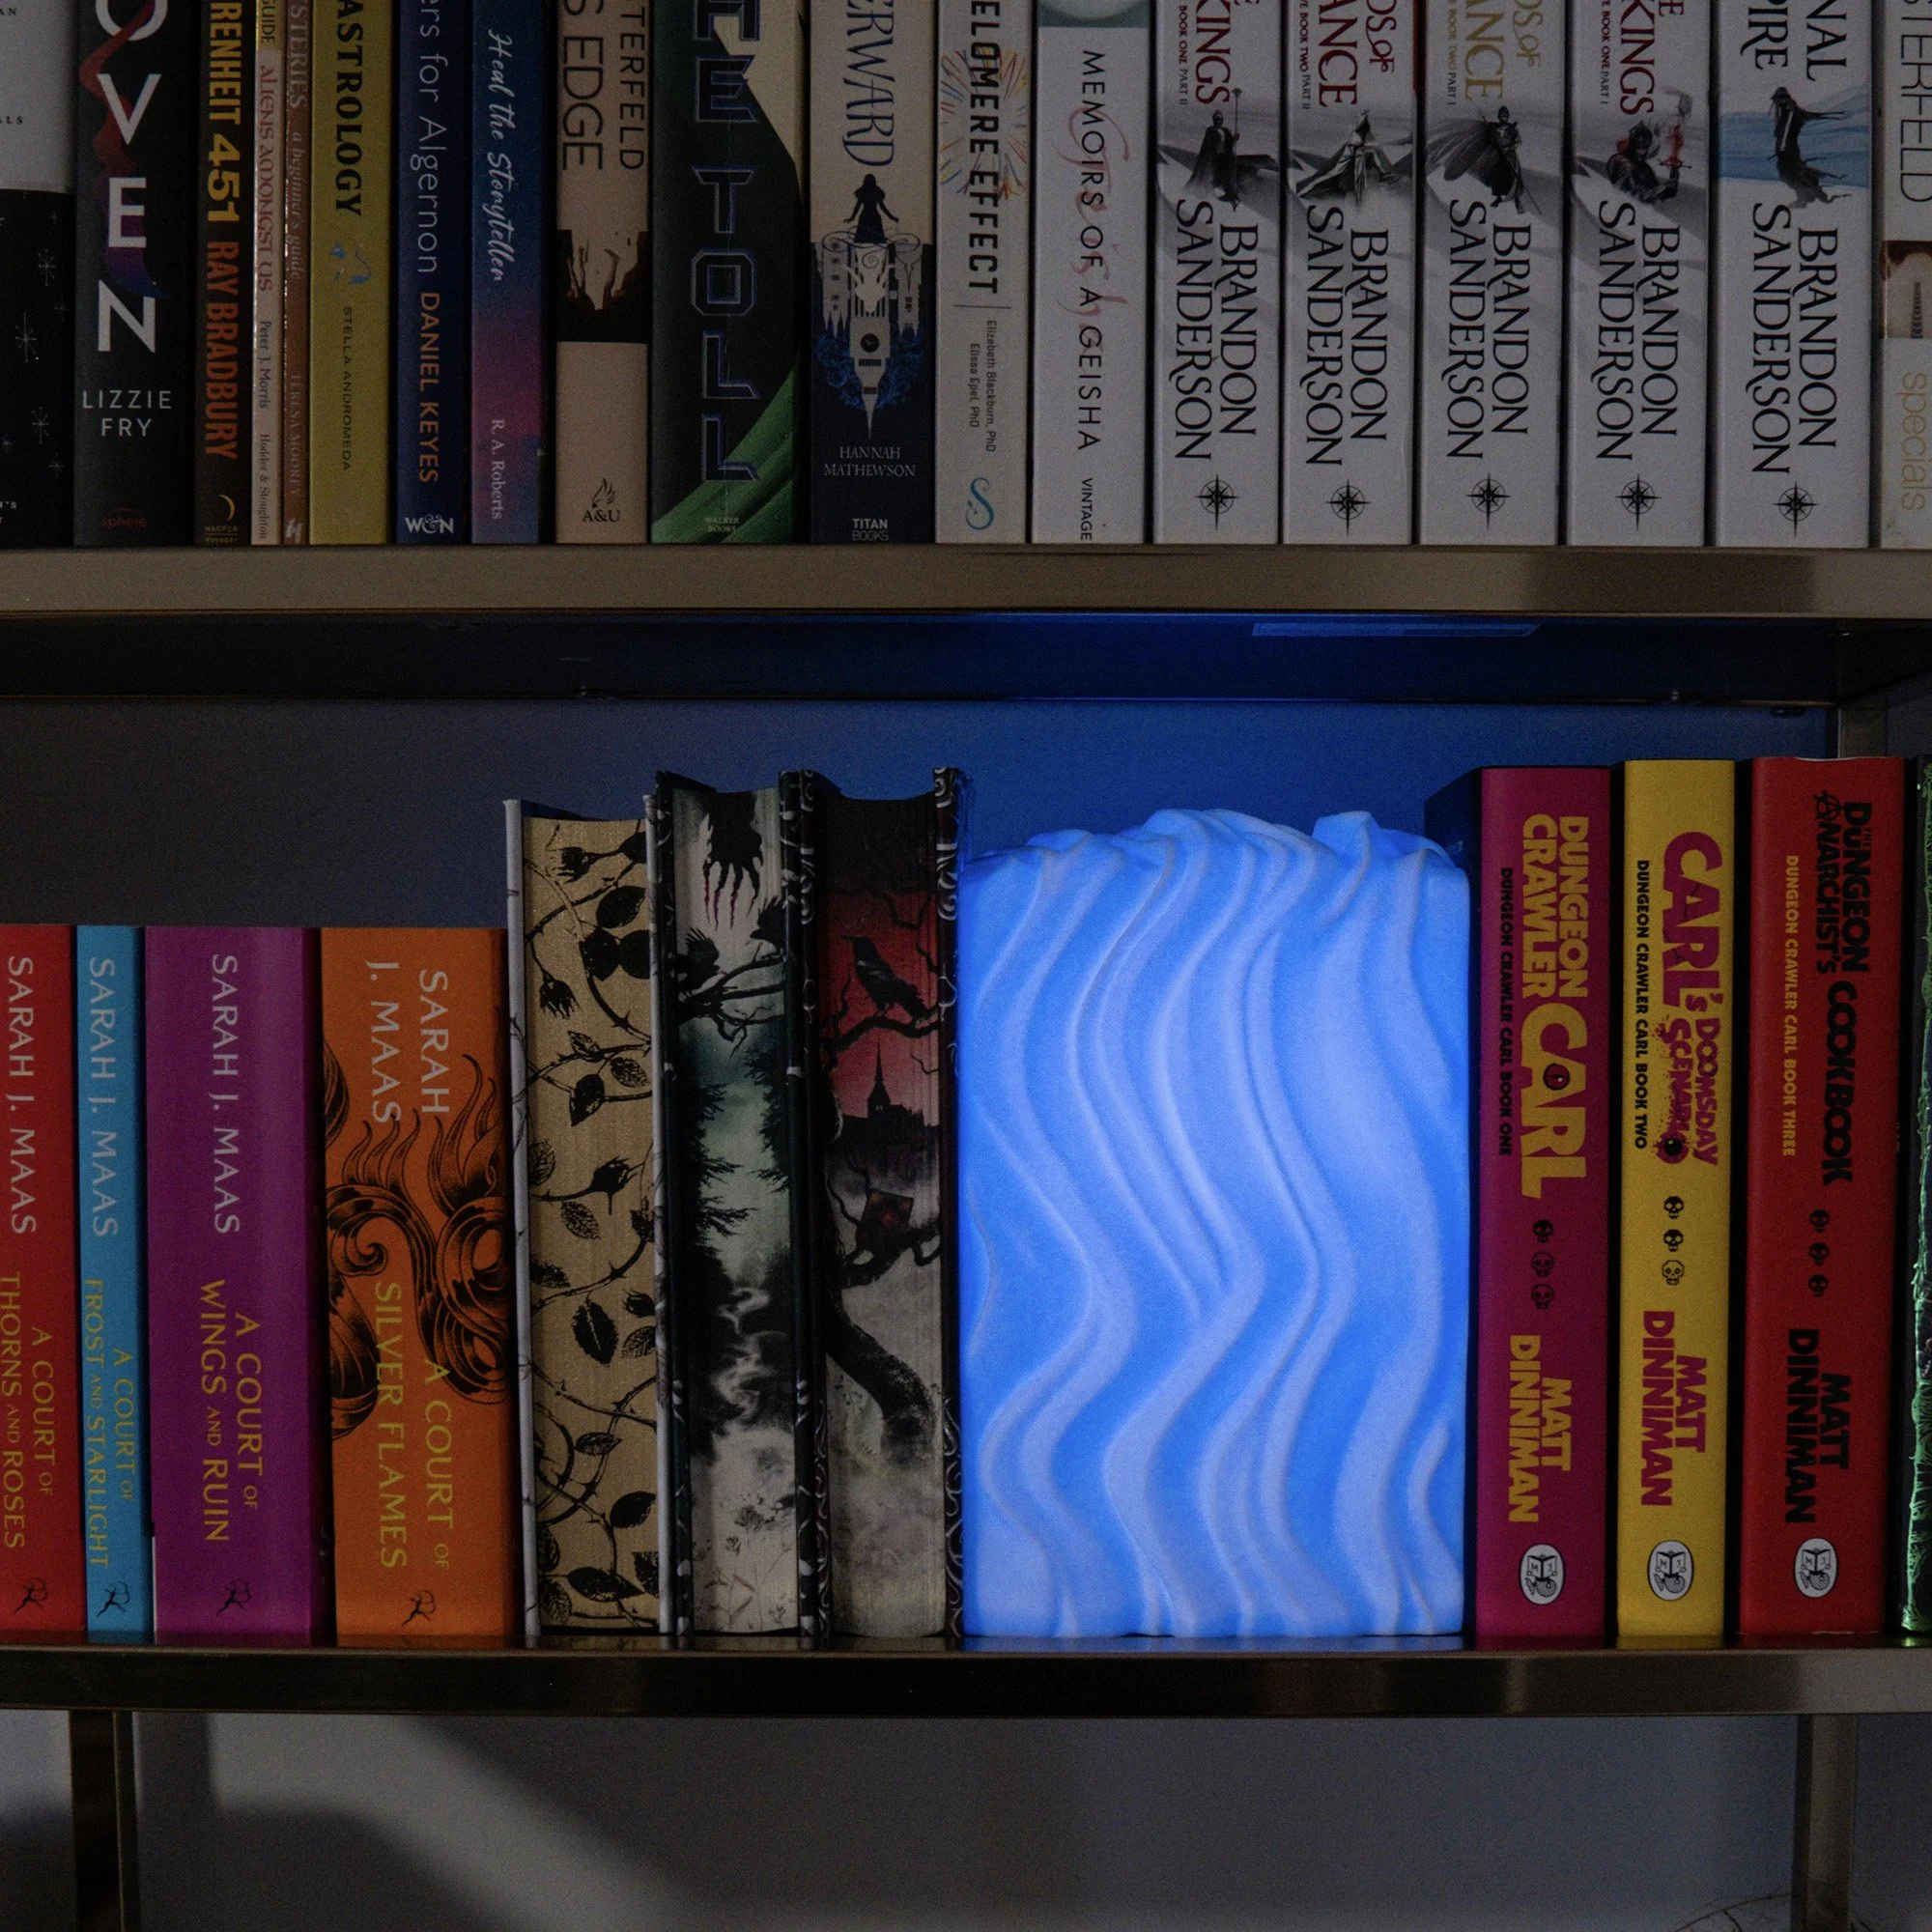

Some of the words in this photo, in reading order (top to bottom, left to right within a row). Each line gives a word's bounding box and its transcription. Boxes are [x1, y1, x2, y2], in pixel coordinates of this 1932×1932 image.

[1179, 5, 1188, 38] BOOK
[1179, 41, 1188, 65] ONE
[1299, 13, 1309, 43] BOOK
[1601, 9, 1610, 43] BOOK
[1601, 45, 1610, 70] ONE
[418, 53, 448, 102] for
[488, 29, 515, 98] Heal
[619, 6, 645, 170] TERFELD
[1179, 69, 1188, 96] PART
[1299, 46, 1309, 71] TWO
[1301, 74, 1311, 98] PART
[1447, 71, 1457, 99] PART
[1600, 71, 1609, 98] PART
[335, 0, 363, 216] ASTROLOGY
[488, 102, 516, 140] the
[562, 36, 604, 170] EDGE
[1080, 50, 1105, 206] MEMOIRS
[207, 132, 241, 222] 451
[410, 115, 447, 273] Algernon
[482, 151, 516, 281] Storyteller
[968, 170, 999, 294] EFFECT
[1080, 225, 1104, 268] OF
[207, 241, 240, 296] RAY
[258, 262, 273, 292] US
[1079, 286, 1102, 306] A
[259, 320, 272, 352] Peter
[343, 305, 353, 365] STELLA
[418, 292, 440, 393] DANIEL
[690, 162, 761, 483] TOLL
[985, 320, 997, 370] Elizabeth
[1169, 199, 1213, 461] SANDERSON
[1214, 223, 1259, 435] BRANDON
[1299, 205, 1344, 465] SANDERSON
[1345, 229, 1388, 440] BRANDON
[1441, 198, 1487, 459] SANDERSON
[1487, 223, 1531, 435] BRANDON
[1591, 200, 1635, 461] SANDERSON
[1636, 224, 1680, 436] BRANDON
[1746, 202, 1791, 473] SANDERSON
[1792, 227, 1838, 446] BRANDON
[204, 302, 240, 462] BRADBURY
[258, 368, 271, 409] Morris
[969, 343, 980, 375] Elissa
[1078, 326, 1102, 450] GEISHA
[82, 389, 172, 409] LIZZIE
[101, 417, 152, 437] FRY
[342, 370, 353, 471] ANDROMEDA
[491, 418, 505, 435] R.
[969, 406, 980, 428] PhD
[418, 401, 440, 483] KEYES
[491, 439, 505, 456] A.
[823, 464, 917, 477] MATHEWSON
[838, 446, 900, 460] HANNAH
[985, 431, 997, 452] PhD
[405, 514, 455, 534] W&N
[491, 460, 505, 521] Roberts
[582, 509, 620, 523] A&U
[851, 517, 889, 528] TITAN
[1080, 477, 1094, 541] VINTAGE
[851, 528, 889, 541] BOOKS
[1500, 867, 1514, 947] DUNGEON
[1521, 813, 1558, 1000] CRAWLER
[1558, 815, 1590, 999] DUNGEON
[1636, 860, 1650, 939] DUNGEON
[1785, 855, 1800, 934] DUNGEON
[1841, 802, 1872, 973] DUNGEON
[365, 961, 399, 981] J.
[1499, 951, 1513, 1023] CRAWLER
[1635, 943, 1649, 1015] CRAWLER
[1784, 938, 1799, 1010] CRAWLER
[8, 955, 35, 1077] SARAH
[90, 956, 117, 1079] SARAH
[212, 953, 239, 1077] SARAH
[418, 969, 450, 1114] SARAH
[1499, 1027, 1513, 1066] CARL
[1635, 1019, 1649, 1059] CARL
[1783, 1014, 1798, 1054] CARL
[370, 1000, 402, 1124] MAAS
[1499, 1070, 1513, 1118] BOOK
[1634, 1063, 1648, 1110] BOOK
[1692, 1017, 1719, 1165] DOOMSDAY
[1782, 1058, 1797, 1106] BOOK
[1823, 980, 1858, 1185] COOKBOOK
[5, 1094, 35, 1112] J.
[88, 1097, 117, 1113] J.
[208, 1093, 239, 1111] J.
[1520, 1002, 1589, 1200] CARL
[1634, 1114, 1648, 1150] TWO
[1781, 1109, 1796, 1157] THREE
[1498, 1122, 1512, 1156] ONE
[10, 1128, 37, 1235] MAAS
[92, 1130, 118, 1236] MAAS
[213, 1127, 240, 1235] MAAS
[0, 1271, 22, 1397] THORNS
[31, 1326, 52, 1346] A
[84, 1279, 105, 1367] FROST
[114, 1348, 133, 1367] A
[199, 1279, 227, 1396] WINGS
[235, 1312, 260, 1338] A
[374, 1281, 404, 1406] SILVER
[89, 1375, 103, 1409] AND
[425, 1358, 450, 1384] A
[1674, 1354, 1707, 1453] MATT
[7, 1404, 21, 1444] AND
[31, 1359, 56, 1465] COURT
[114, 1378, 137, 1473] COURT
[206, 1406, 221, 1446] AND
[235, 1352, 263, 1477] COURT
[1508, 1334, 1542, 1523] DINNIMAN
[1541, 1377, 1572, 1471] MATT
[1641, 1310, 1675, 1506] DINNIMAN
[1785, 1328, 1819, 1523] DINNIMAN
[1820, 1374, 1851, 1469] MATT
[1, 1451, 25, 1548] ROSES
[39, 1472, 53, 1495] OF
[86, 1416, 109, 1569] STARLIGHT
[119, 1479, 134, 1500] OF
[202, 1459, 229, 1542] RUIN
[242, 1484, 258, 1510] OF
[377, 1422, 407, 1570] FLAMES
[425, 1399, 454, 1530] COURT
[434, 1544, 450, 1570] OF
